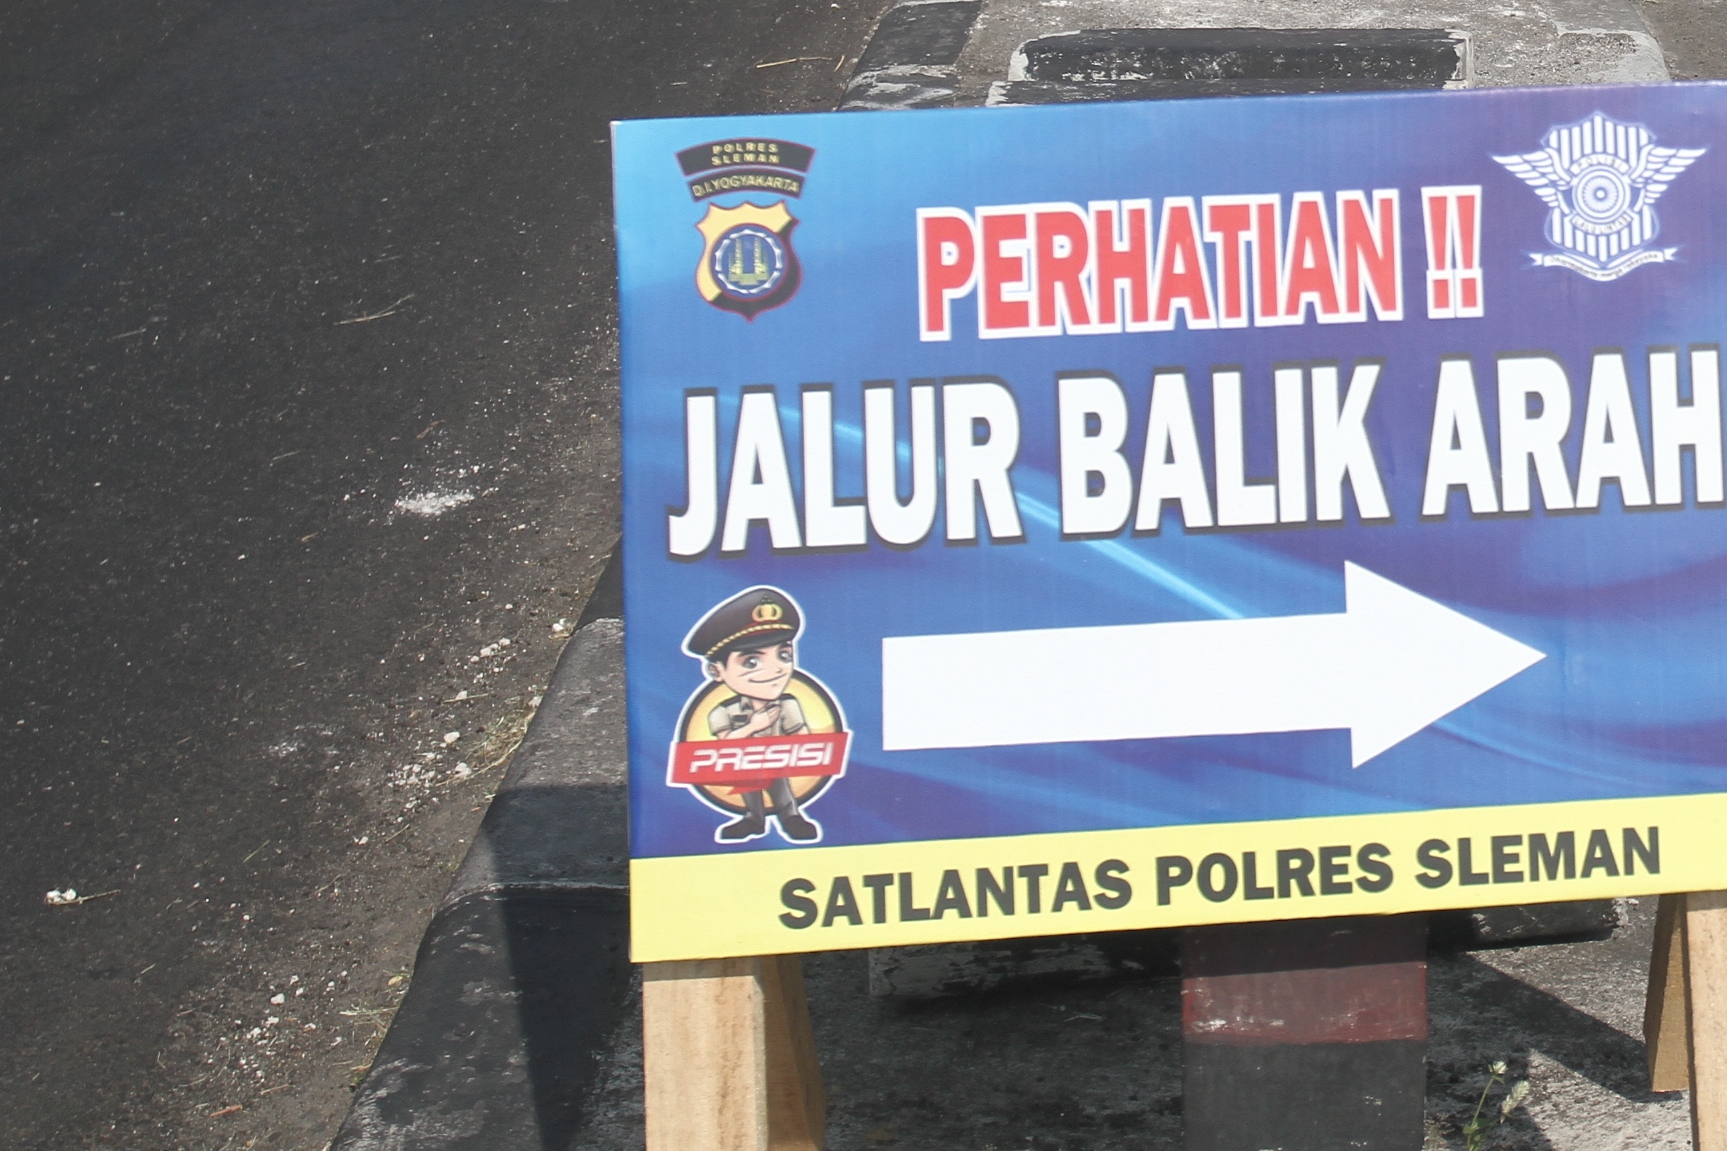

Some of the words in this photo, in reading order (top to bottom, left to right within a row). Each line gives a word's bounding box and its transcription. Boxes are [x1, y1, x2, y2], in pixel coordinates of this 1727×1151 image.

[711, 153, 779, 166] SLEMAN
[712, 142, 778, 155] POLRES
[916, 189, 1403, 342] PERHATIAN
[1421, 185, 1483, 320] !!
[667, 379, 1025, 560] JALUR
[1055, 360, 1393, 539] BALIK
[1421, 345, 1726, 517] ARAH
[689, 742, 833, 773] PRESISI
[778, 858, 1132, 930] SATLANTAS
[1155, 842, 1394, 906] POLRES
[1414, 825, 1660, 889] SLEMAN
